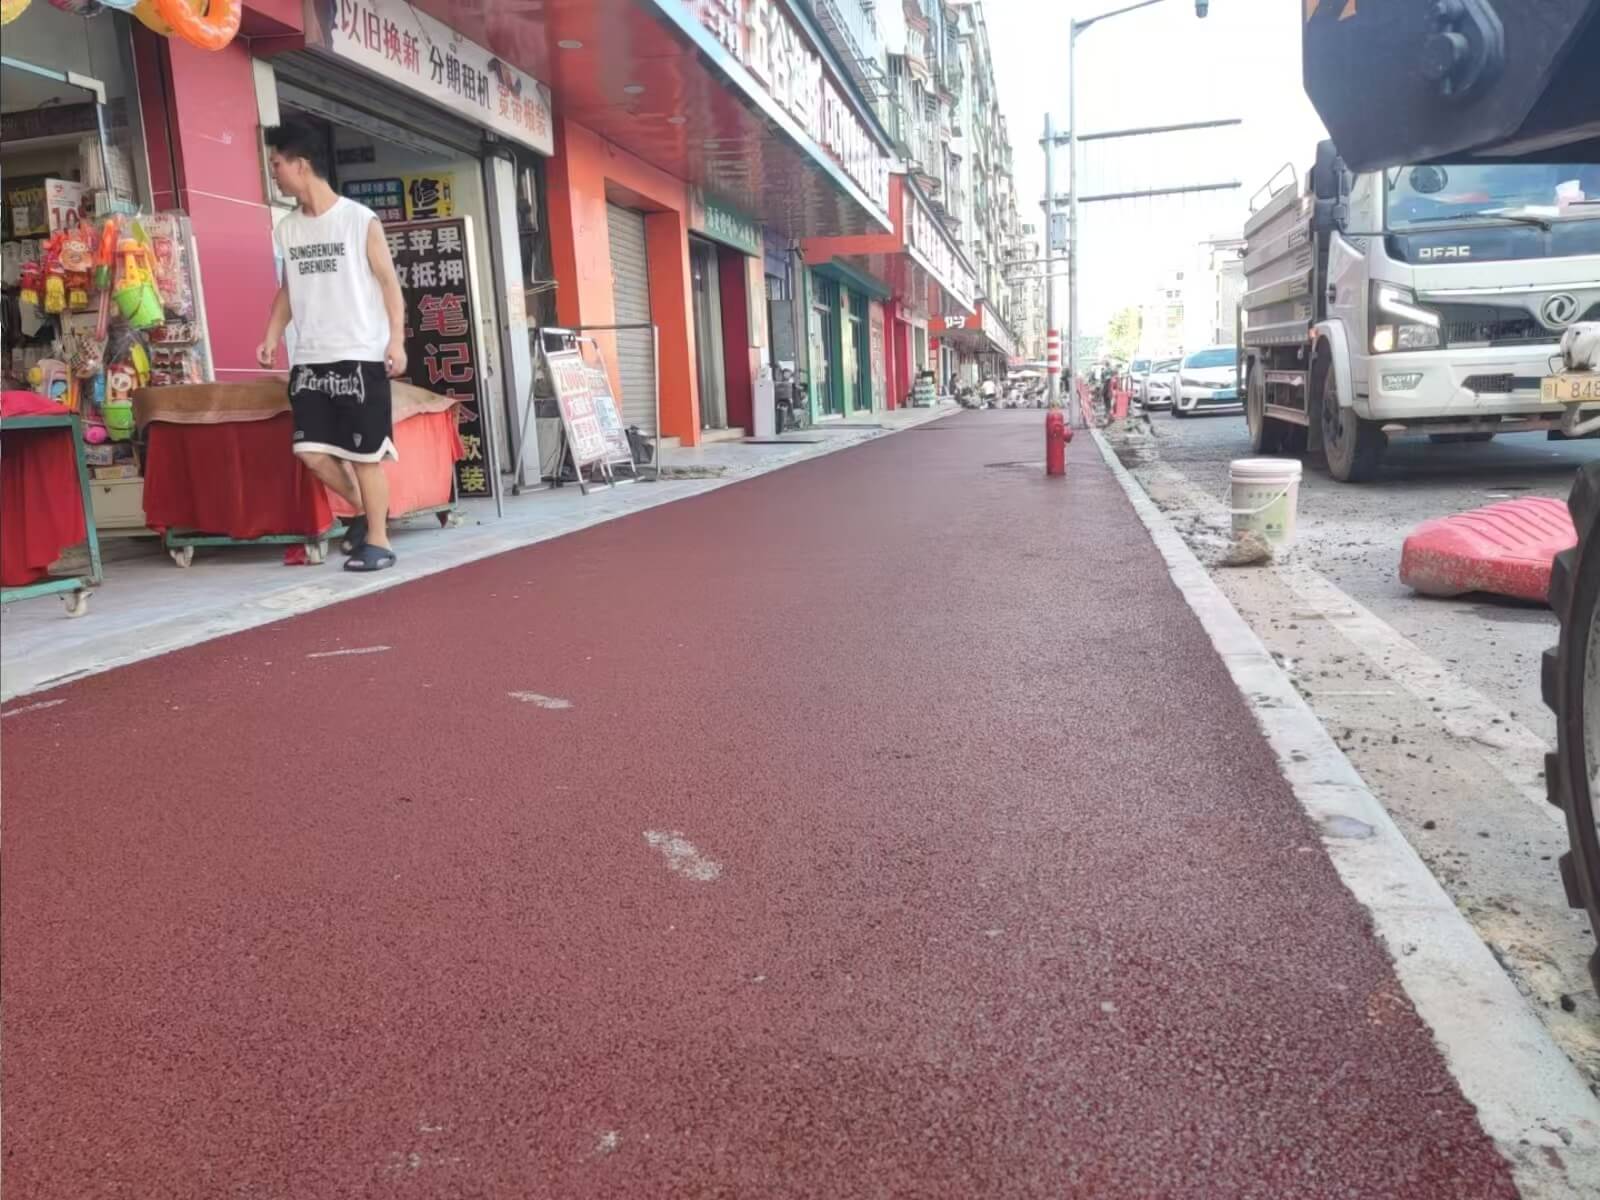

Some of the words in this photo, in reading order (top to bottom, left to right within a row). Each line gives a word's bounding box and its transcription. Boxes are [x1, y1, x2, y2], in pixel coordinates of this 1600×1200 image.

[341, 0, 420, 76] 以旧换新
[430, 45, 491, 110] 分期租机
[298, 258, 338, 275] GRENURE
